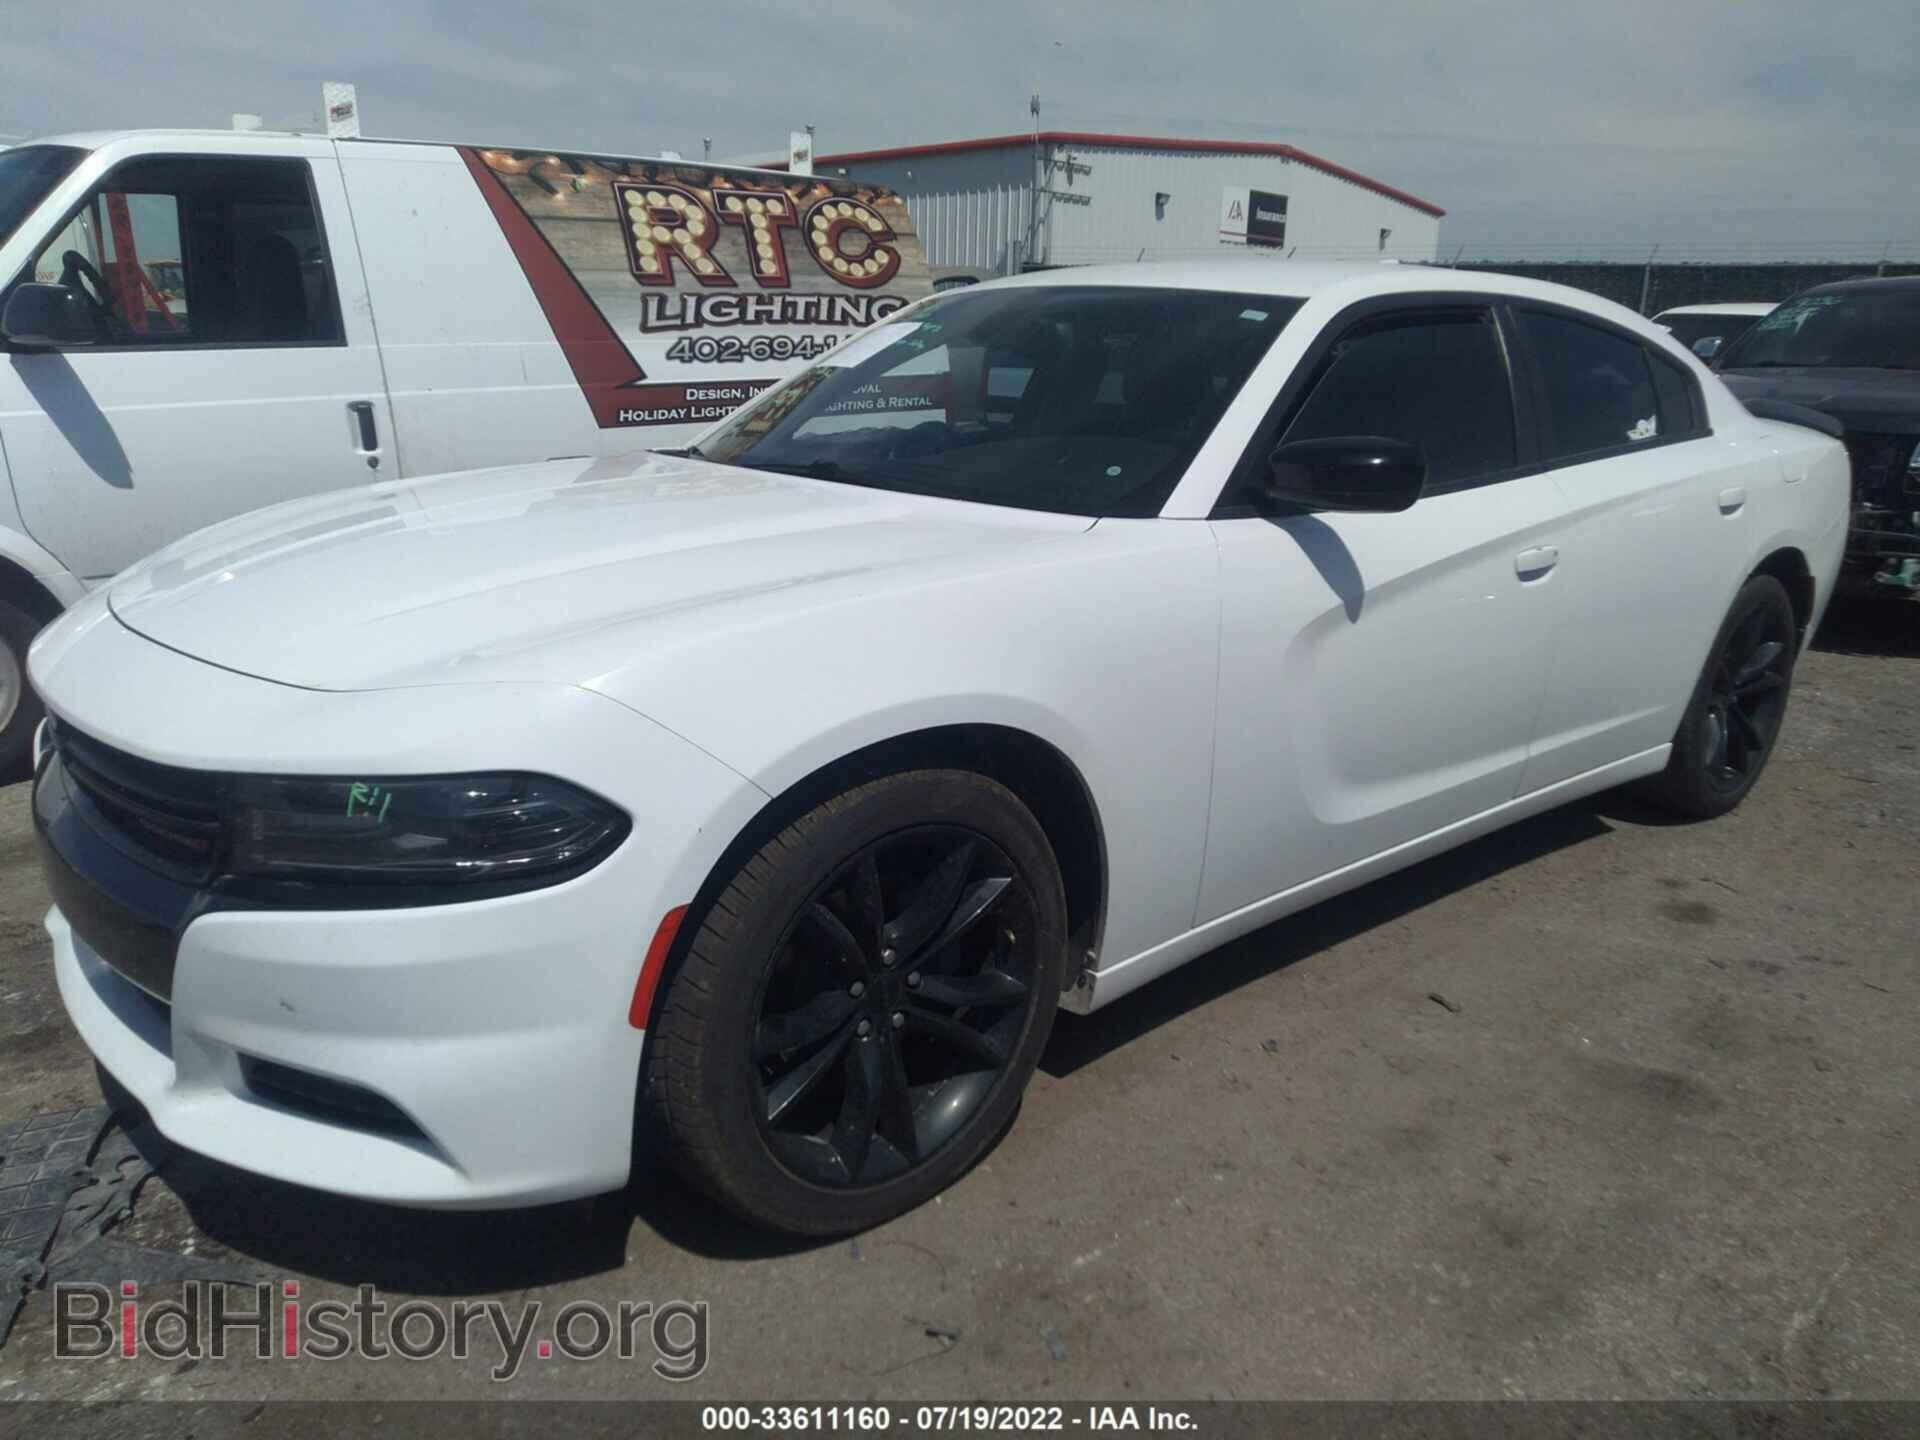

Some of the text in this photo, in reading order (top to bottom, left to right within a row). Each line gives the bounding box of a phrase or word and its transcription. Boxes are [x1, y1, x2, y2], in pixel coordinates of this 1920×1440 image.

[611, 180, 902, 289] RTC
[640, 292, 908, 333] LIGHTING
[666, 334, 851, 363] 402-694-1
[619, 407, 687, 422] HOLIDAY
[888, 396, 933, 408] RENTAL
